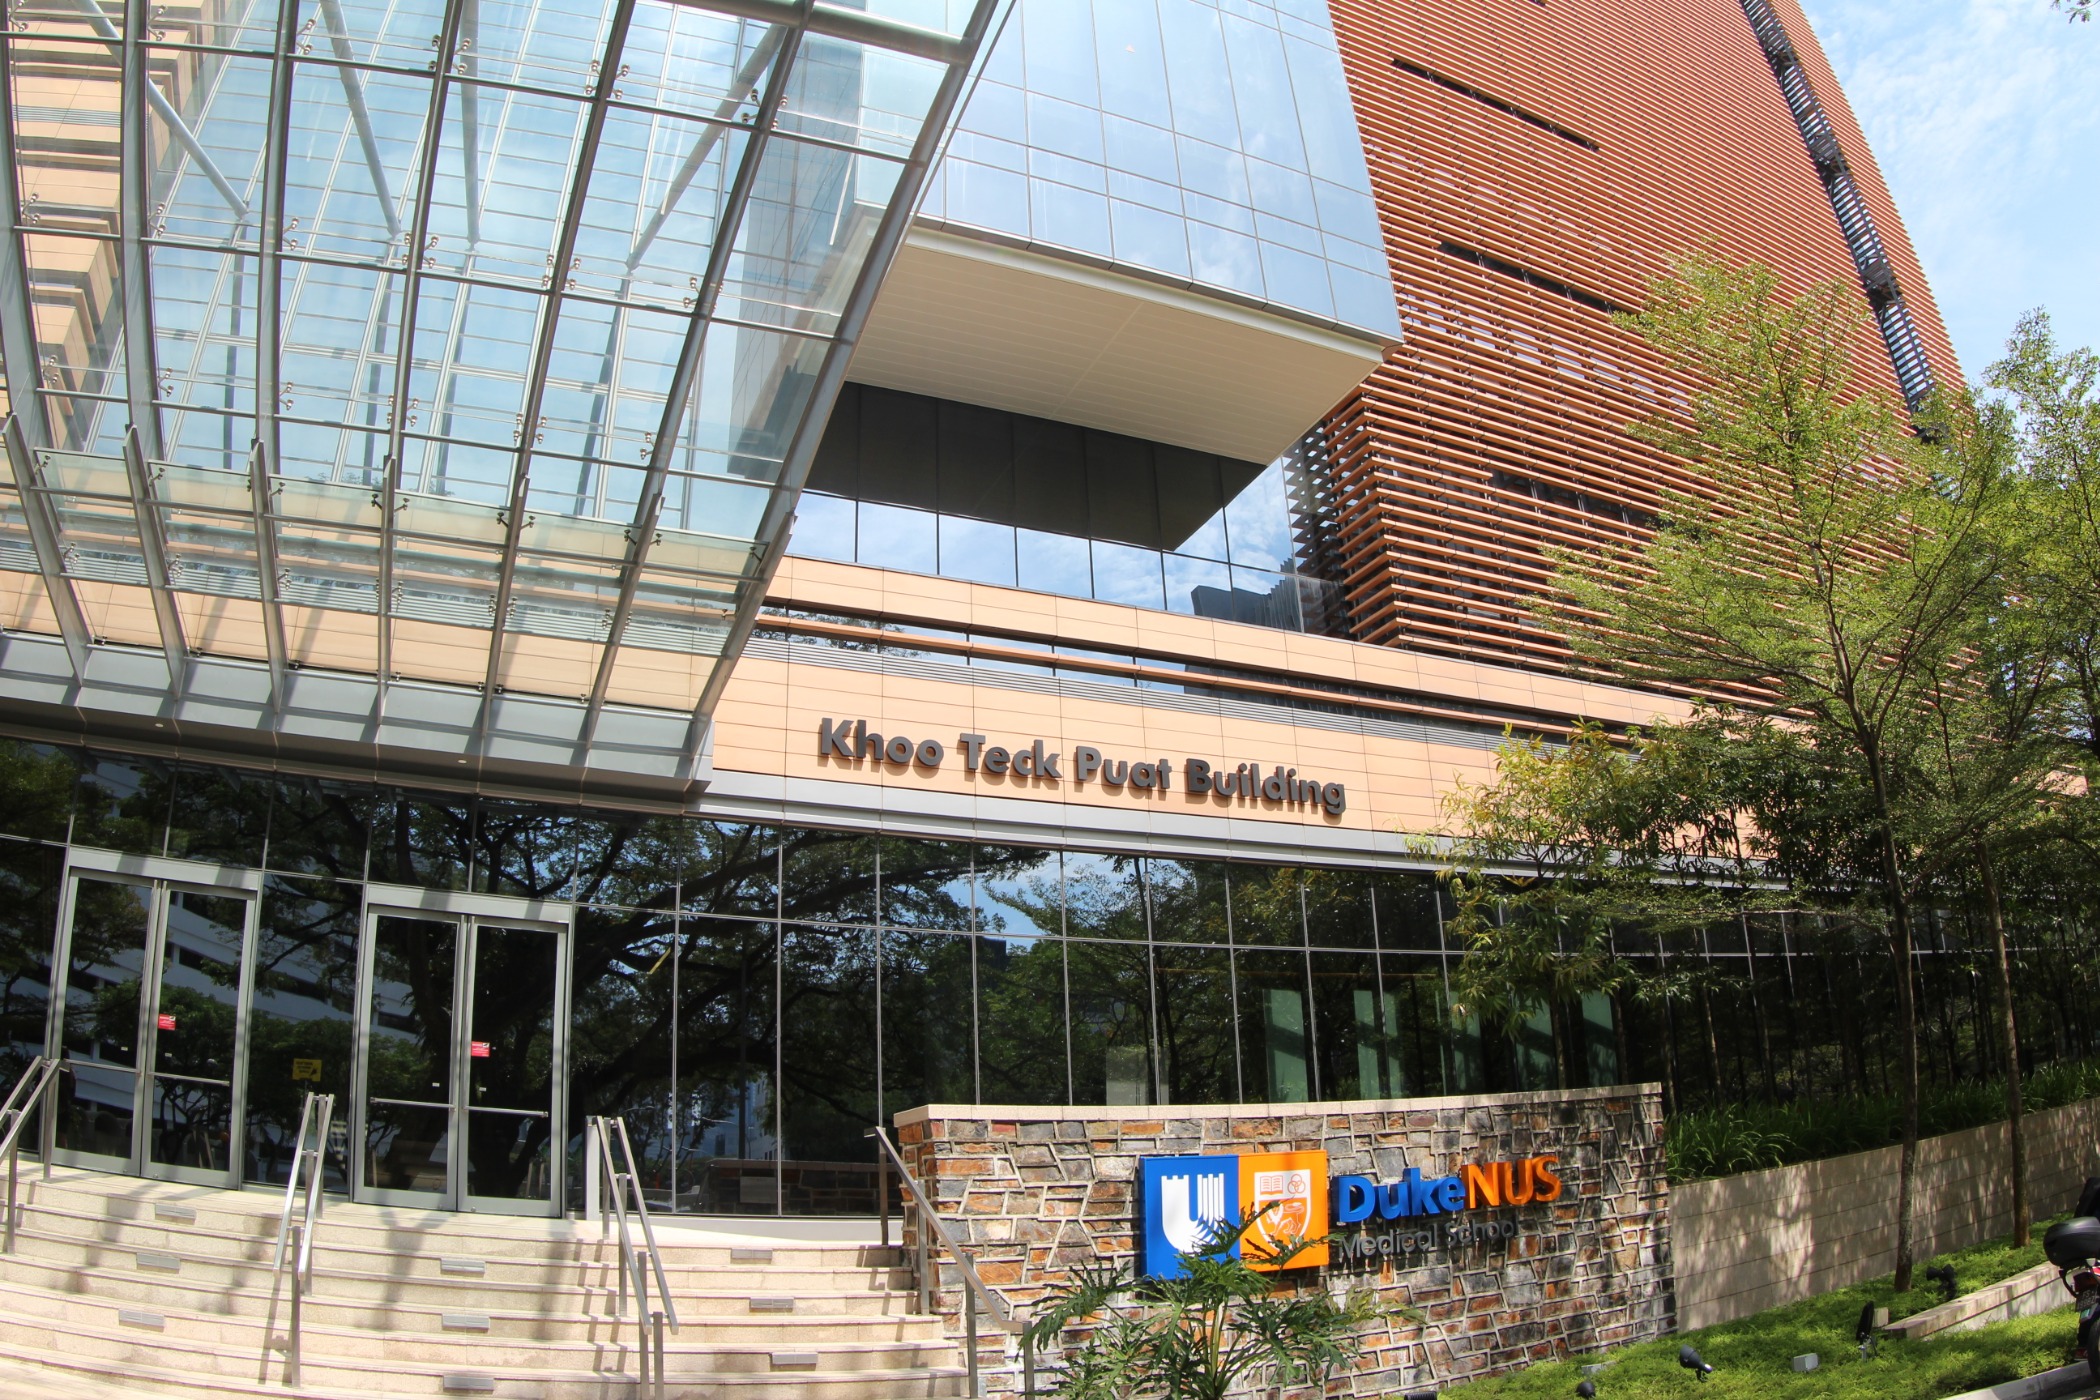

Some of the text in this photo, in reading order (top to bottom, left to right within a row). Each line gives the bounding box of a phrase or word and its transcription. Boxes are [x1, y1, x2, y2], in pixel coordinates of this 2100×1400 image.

[820, 717, 1347, 815] Khoo Teck Puat Building
[1333, 1155, 1562, 1223] DukeNUS
[1338, 1217, 1518, 1259] Medical School
